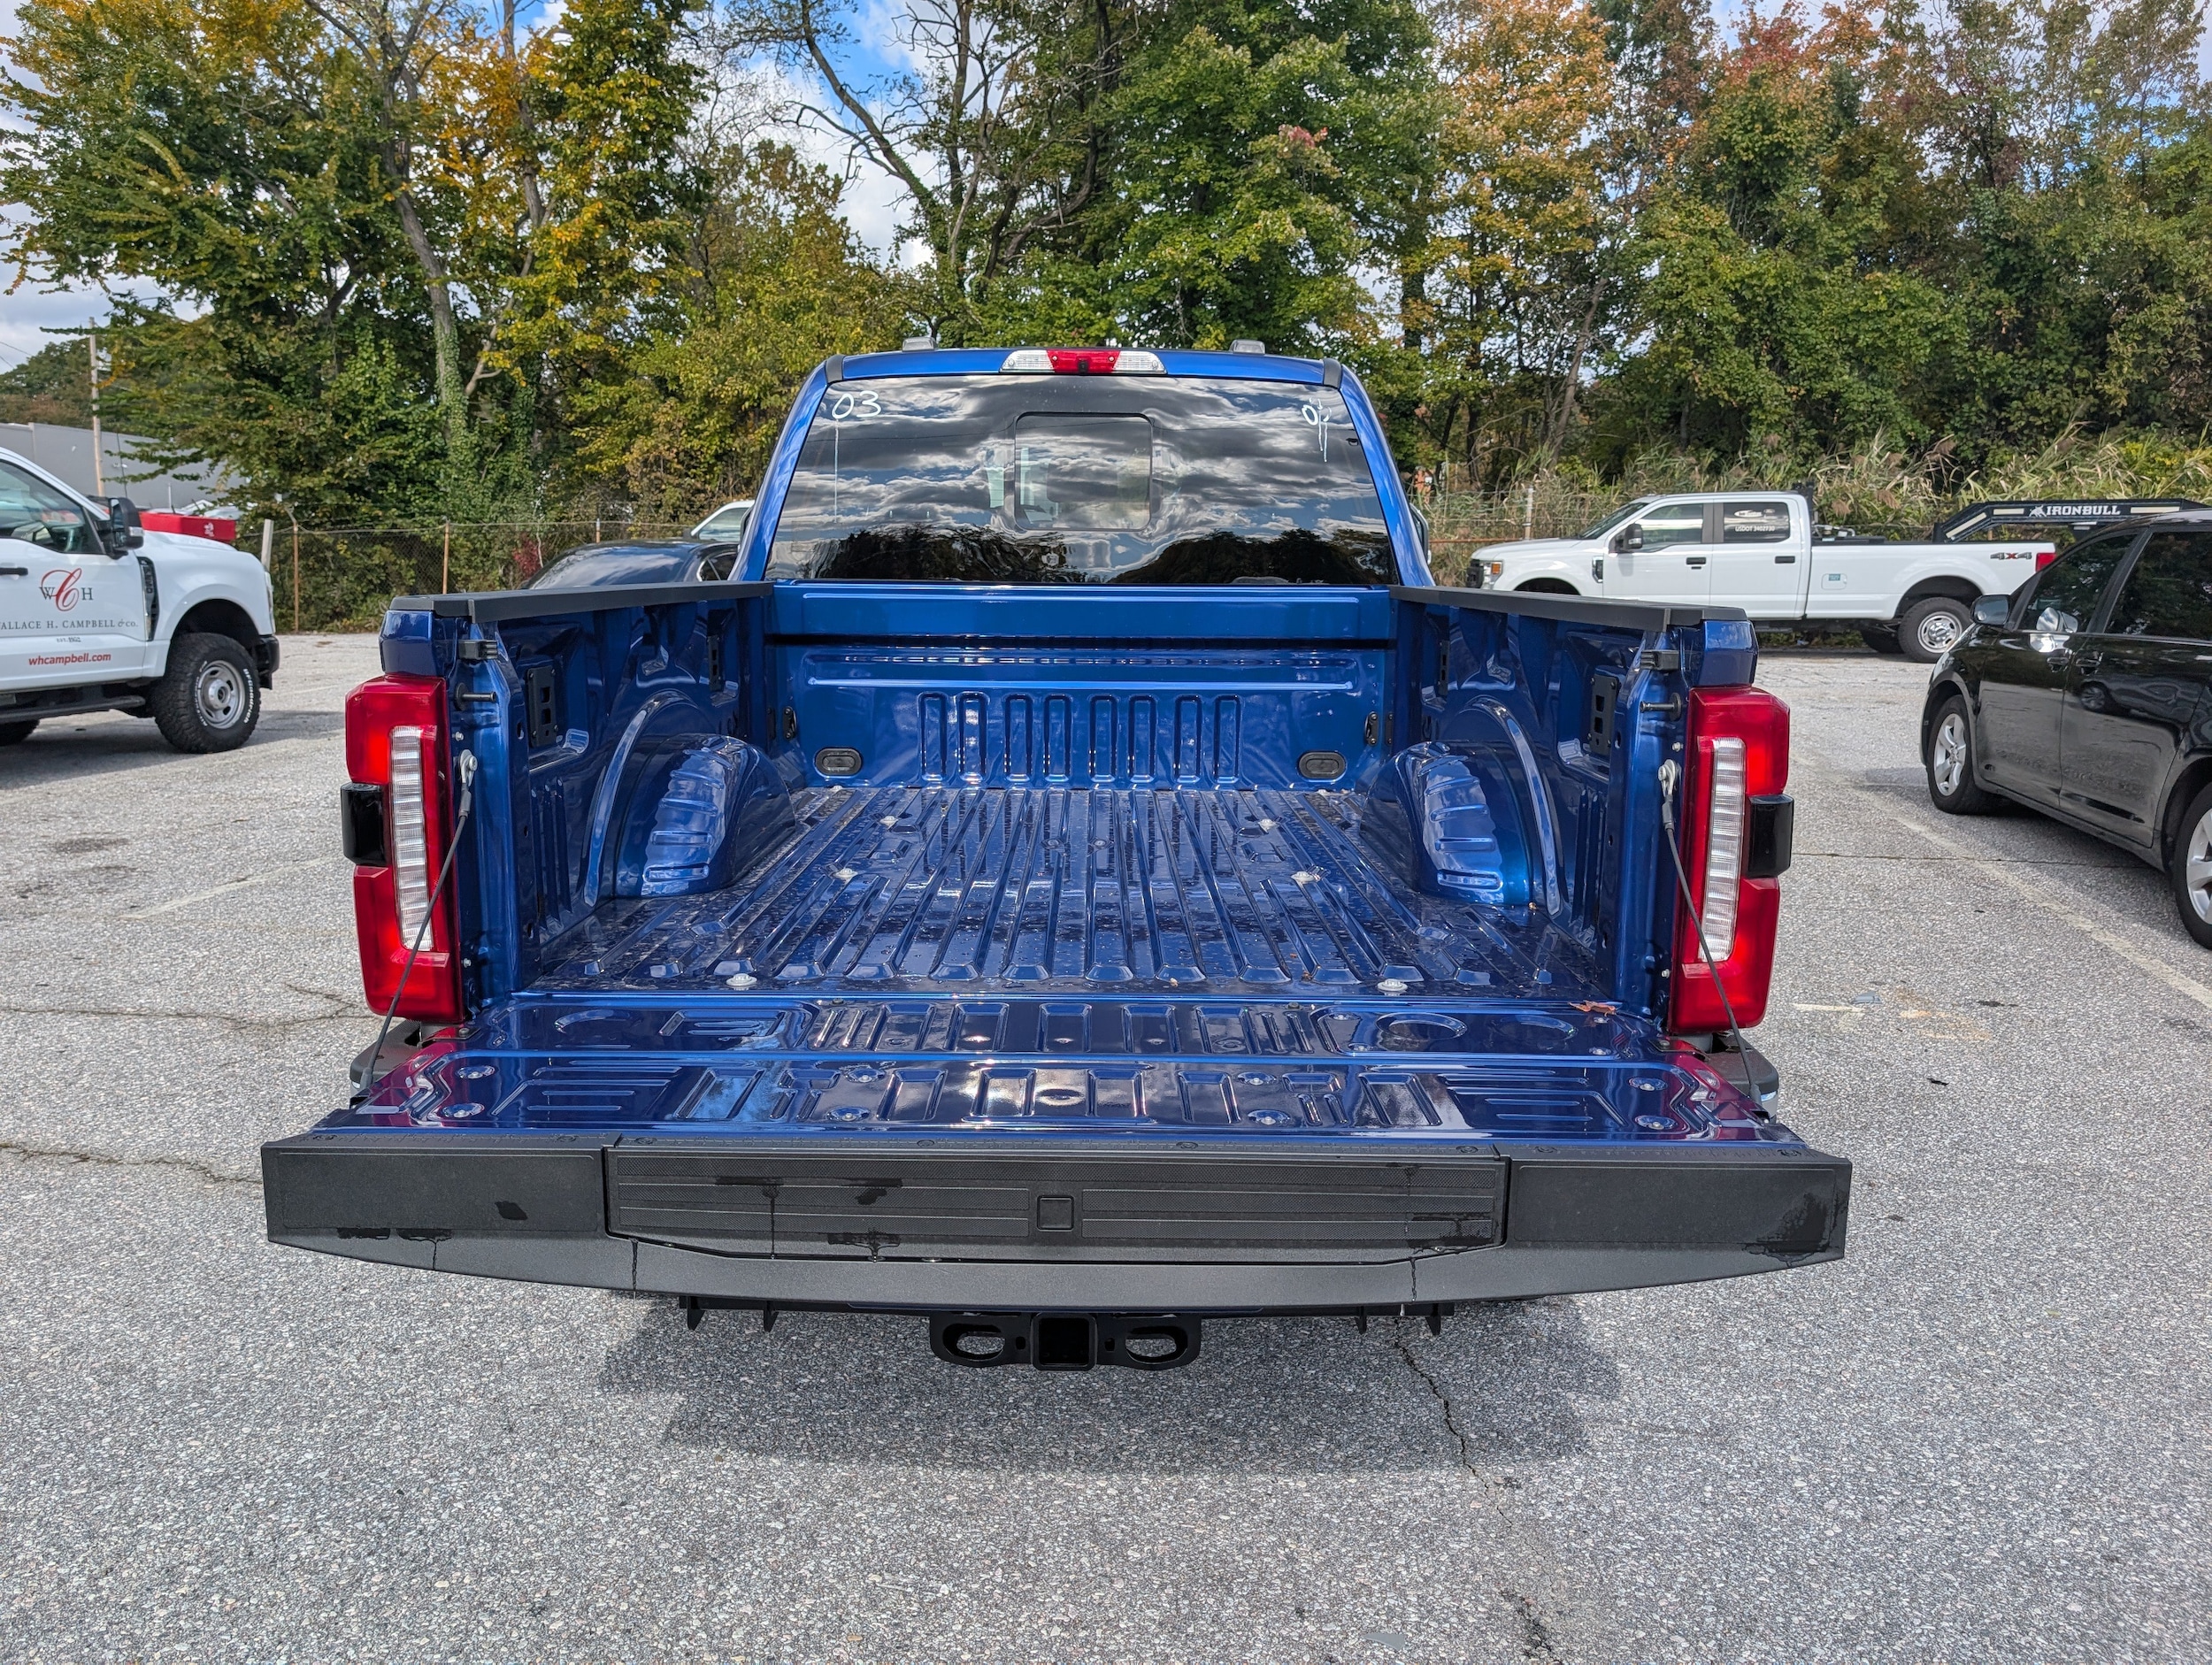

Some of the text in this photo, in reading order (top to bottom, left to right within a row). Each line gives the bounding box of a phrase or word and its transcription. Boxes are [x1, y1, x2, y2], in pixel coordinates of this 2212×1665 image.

[832, 390, 881, 419] 03
[2046, 504, 2121, 517] IRONBULL
[0, 620, 42, 631] ALLACE
[46, 620, 58, 629] H.
[62, 619, 115, 629] CAMPBELL
[28, 652, 111, 665] whcampbell.com
